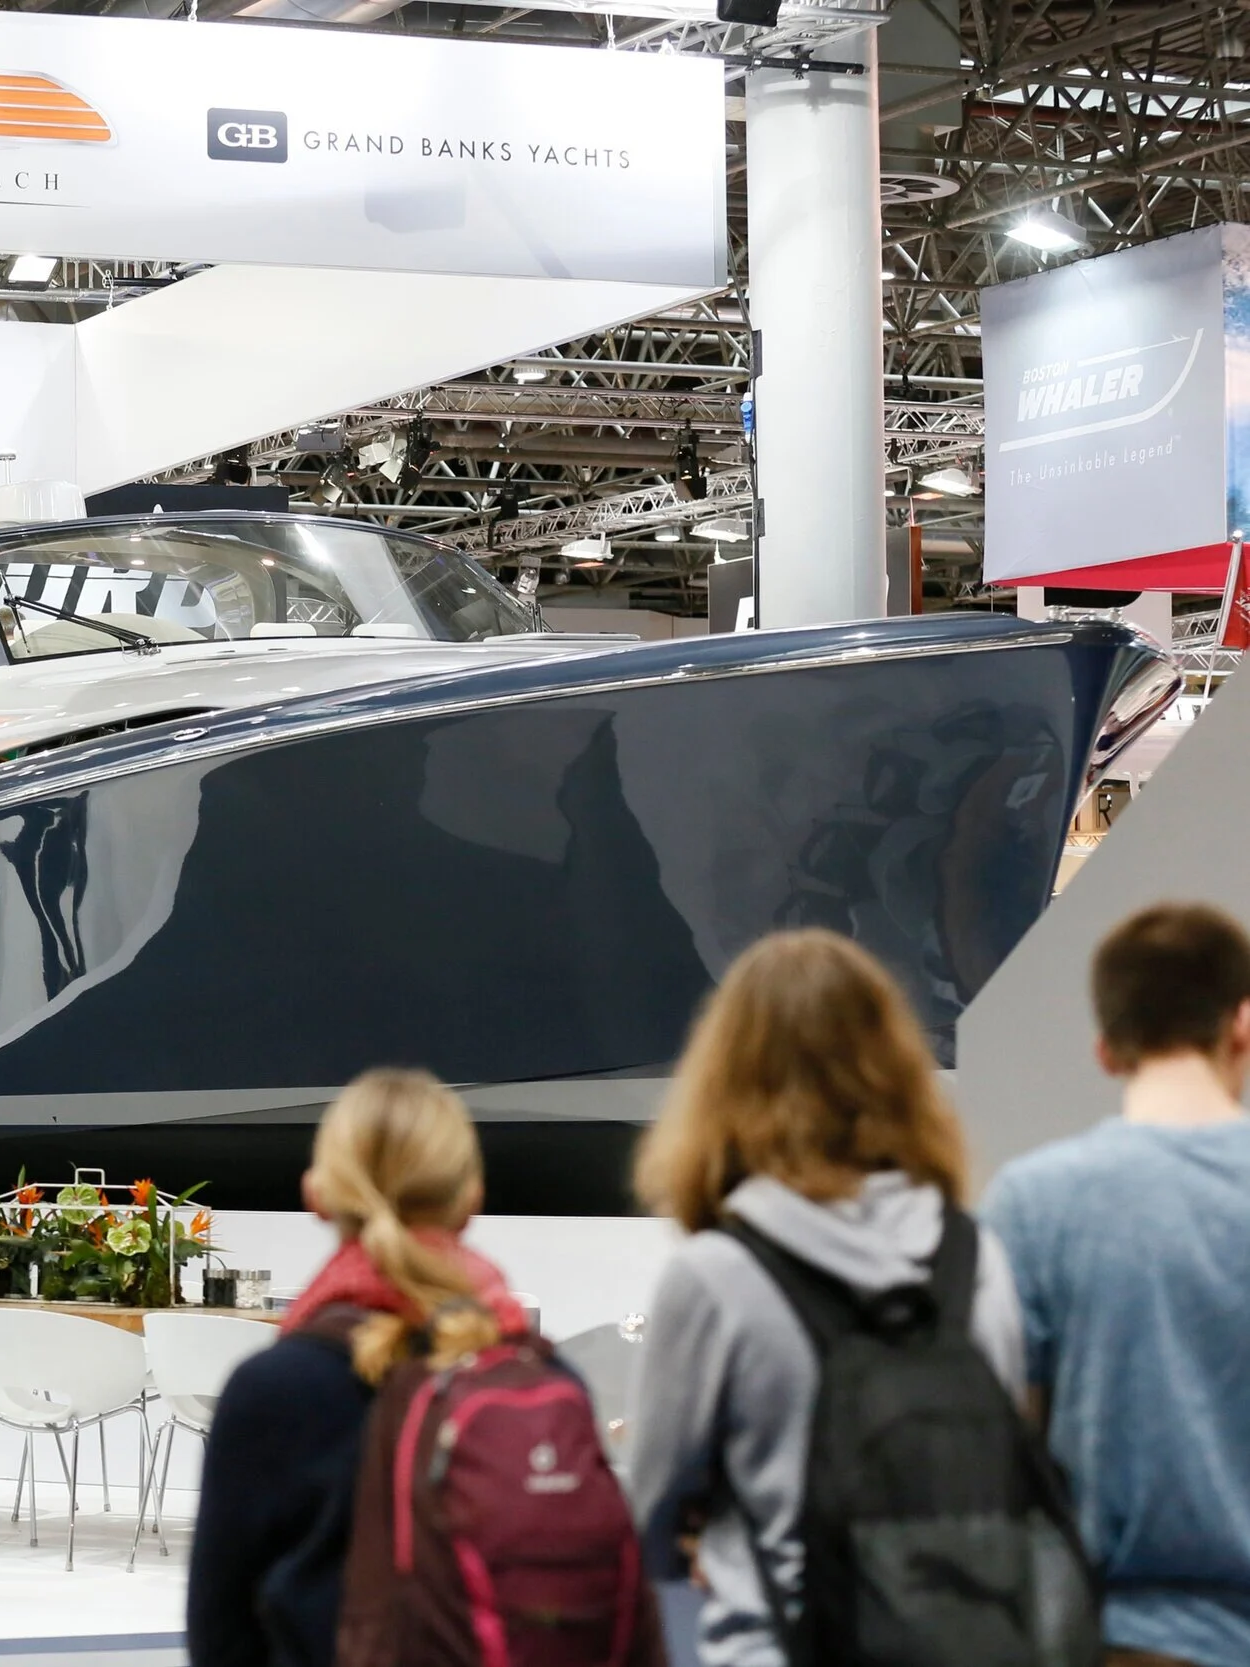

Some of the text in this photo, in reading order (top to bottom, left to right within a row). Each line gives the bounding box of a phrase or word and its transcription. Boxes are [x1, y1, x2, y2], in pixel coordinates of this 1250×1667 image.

[216, 121, 630, 169] GB GRAND BANKS YACHTS
[1017, 364, 1143, 421] WHALER
[1023, 361, 1069, 382] BOSTON
[1009, 436, 1174, 486] The Unsinkable Legend
